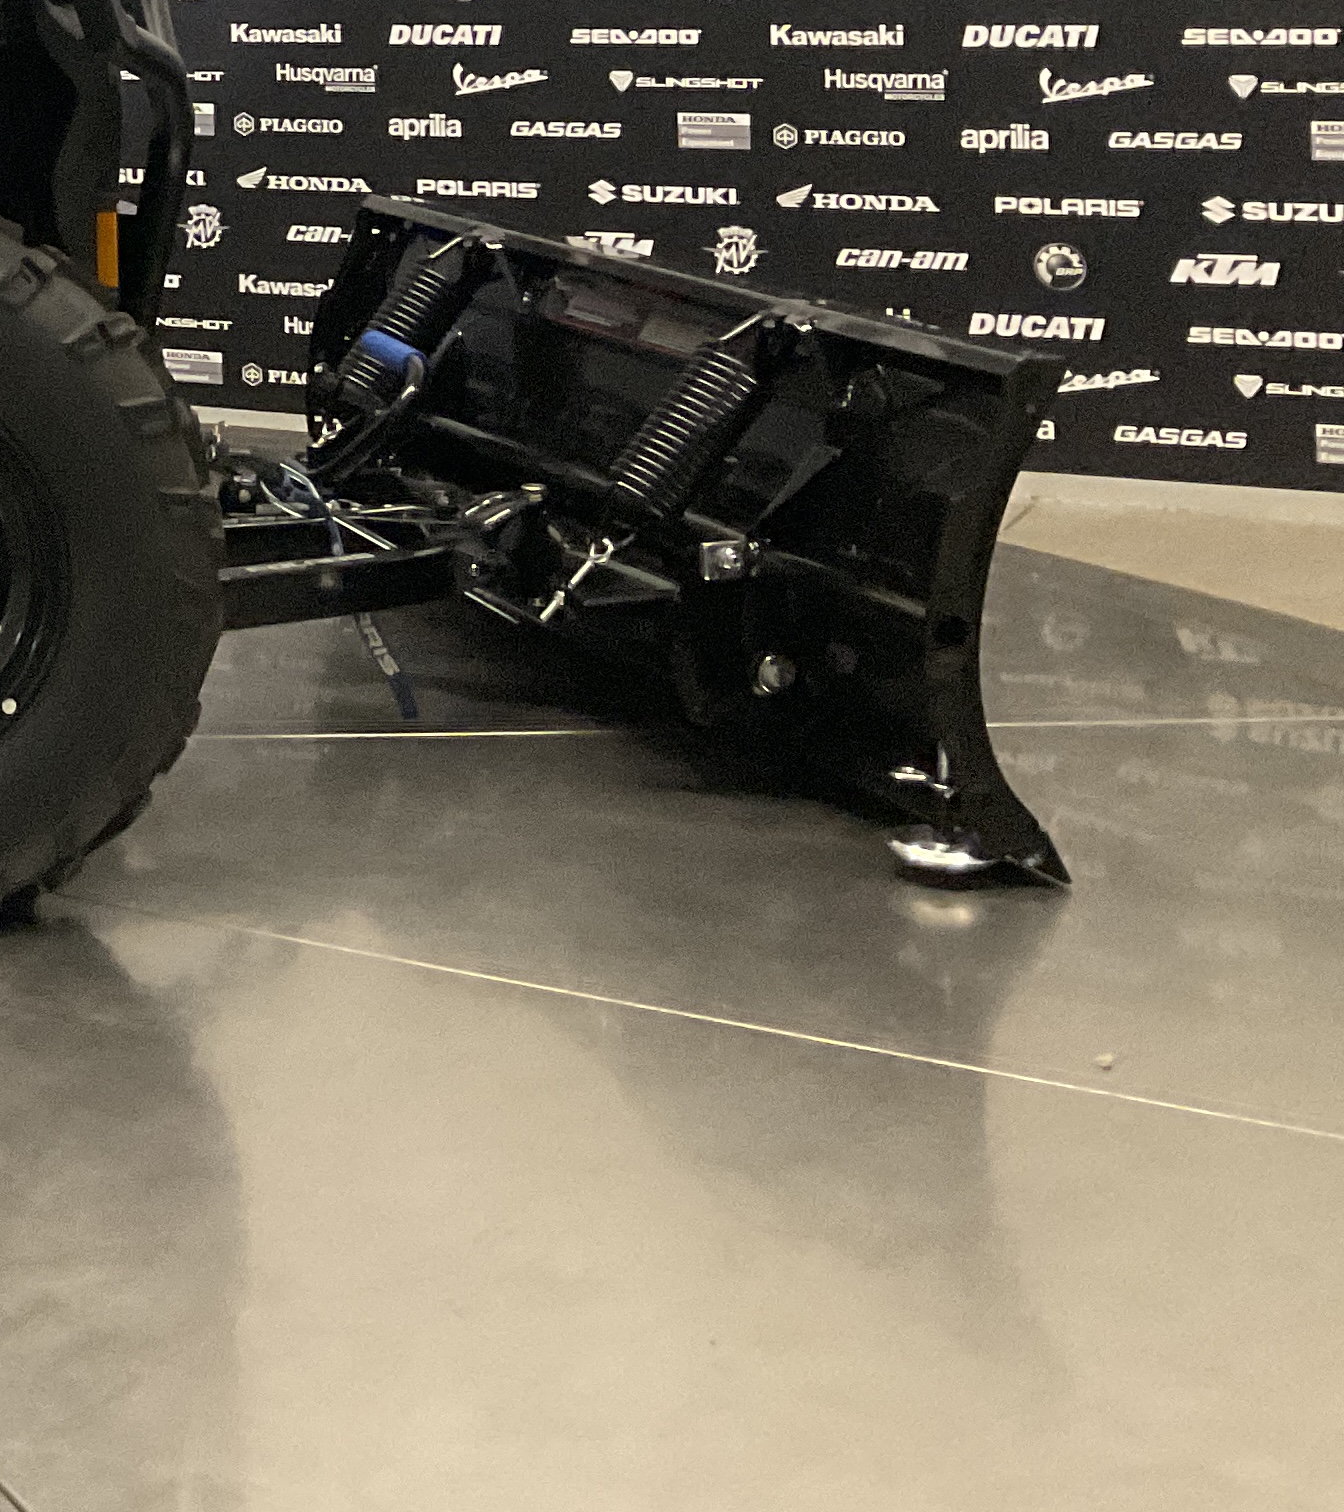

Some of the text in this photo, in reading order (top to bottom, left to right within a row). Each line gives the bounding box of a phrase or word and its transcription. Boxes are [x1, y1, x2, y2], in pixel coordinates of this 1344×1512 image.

[231, 24, 341, 43] Kawasaki
[389, 25, 502, 45] DUCATI
[770, 24, 904, 46] Kawasaki
[962, 25, 1099, 47] DUCATI
[274, 62, 376, 86] Husqvarna
[453, 63, 548, 95] Vespa
[636, 77, 763, 88] SLINGSHOT
[822, 67, 946, 93] Husqvarna
[1039, 68, 1154, 103] Vespa
[260, 118, 343, 133] PIAGGIO
[389, 114, 462, 140] aprilia
[511, 121, 621, 138] GASGAS
[804, 130, 905, 146] PIAGGIO
[961, 124, 1049, 153] aprilia
[1108, 132, 1242, 149] GASGAS
[267, 176, 372, 192] HONDA
[417, 179, 540, 198] POLARIS
[622, 185, 740, 205] SUZUKI
[813, 194, 940, 212] HONDA
[995, 197, 1144, 217] POLARIS
[836, 249, 968, 270] can-am
[1170, 254, 1280, 285] KTM
[969, 313, 1105, 340] DUCATI
[1114, 426, 1247, 448] GASGAS
